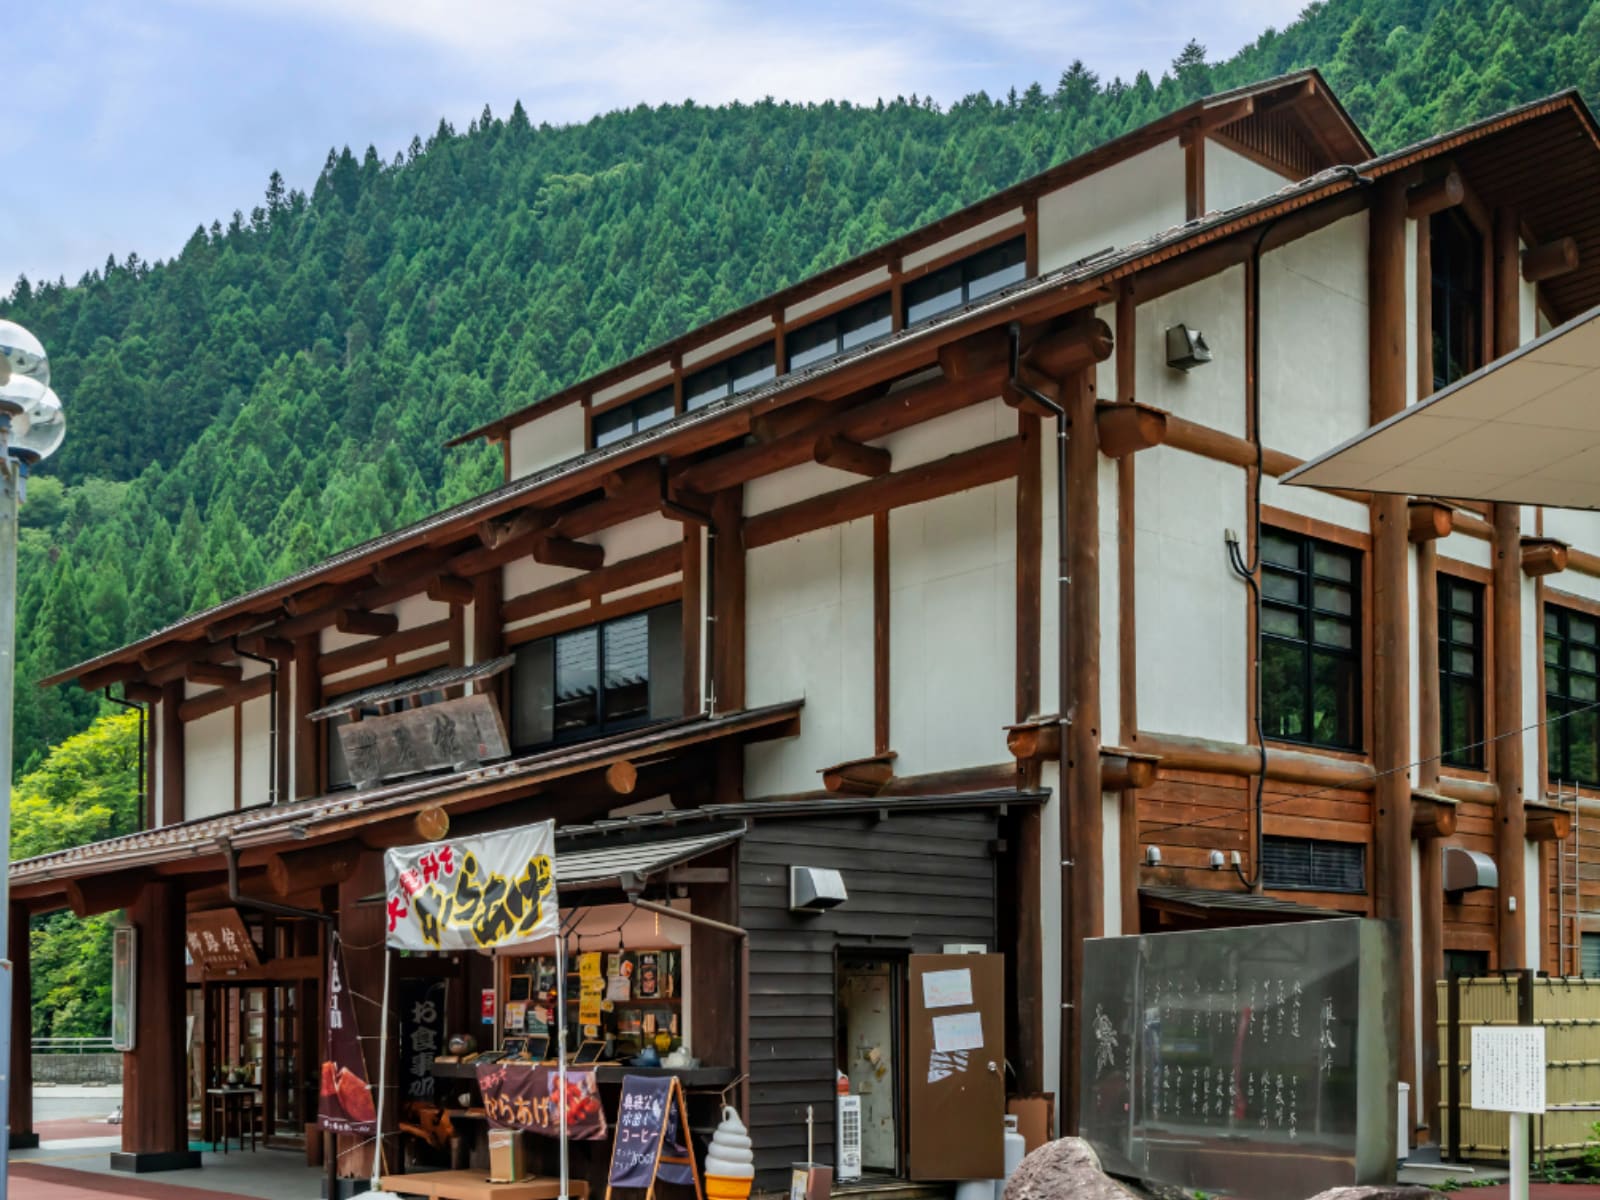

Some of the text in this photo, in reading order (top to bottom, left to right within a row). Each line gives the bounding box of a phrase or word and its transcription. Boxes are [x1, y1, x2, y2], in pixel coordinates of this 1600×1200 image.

[414, 851, 552, 948] からあげ
[408, 1000, 438, 1096] お食事処
[484, 1092, 549, 1128] からあげ
[622, 1128, 660, 1143] コーヒー
